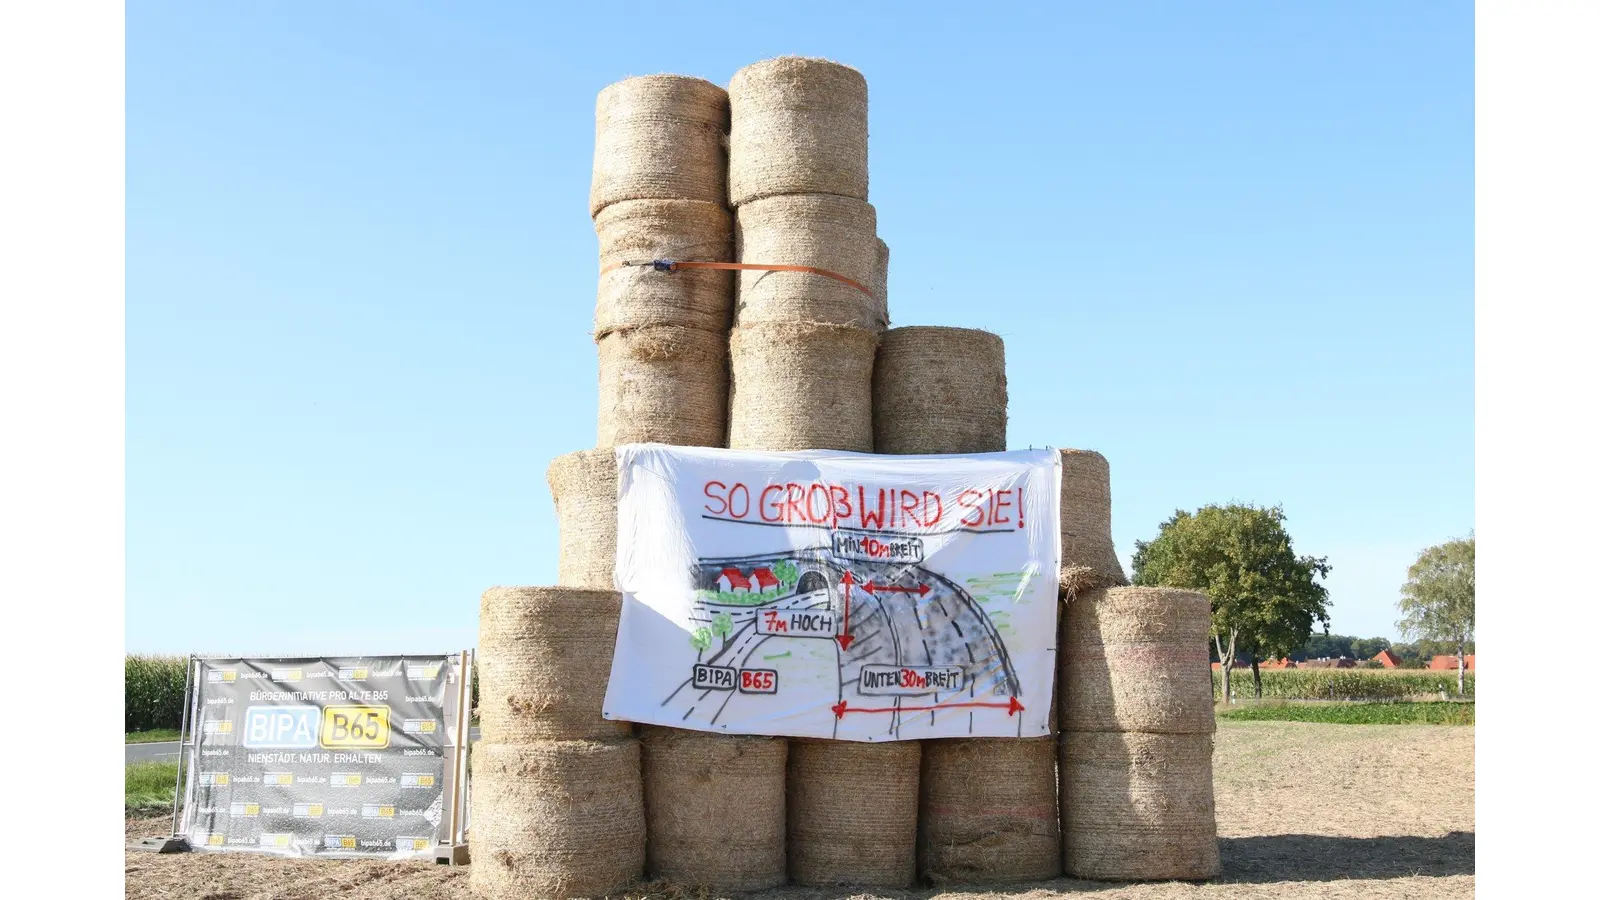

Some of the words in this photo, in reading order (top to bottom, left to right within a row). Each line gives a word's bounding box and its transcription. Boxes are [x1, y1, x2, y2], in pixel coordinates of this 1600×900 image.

[704, 481, 749, 519] SO
[858, 485, 944, 529] WIRD
[957, 487, 1025, 529] SIE!
[790, 613, 832, 633] HOCH
[697, 668, 732, 686] BIPA
[741, 672, 774, 689] B65
[249, 689, 327, 701] BÜRGERINITIATIVE
[328, 691, 347, 700] PRO
[348, 690, 371, 700] ALTE
[372, 690, 388, 700] B65
[249, 713, 312, 743] BIPA
[331, 712, 380, 741] B65
[248, 751, 297, 764] NIENSTÄDT.
[299, 753, 332, 764] NATUR.
[334, 753, 382, 764] ERHALTEN
[403, 748, 435, 757] bipab65.de
[360, 839, 392, 848] bipab65.de
